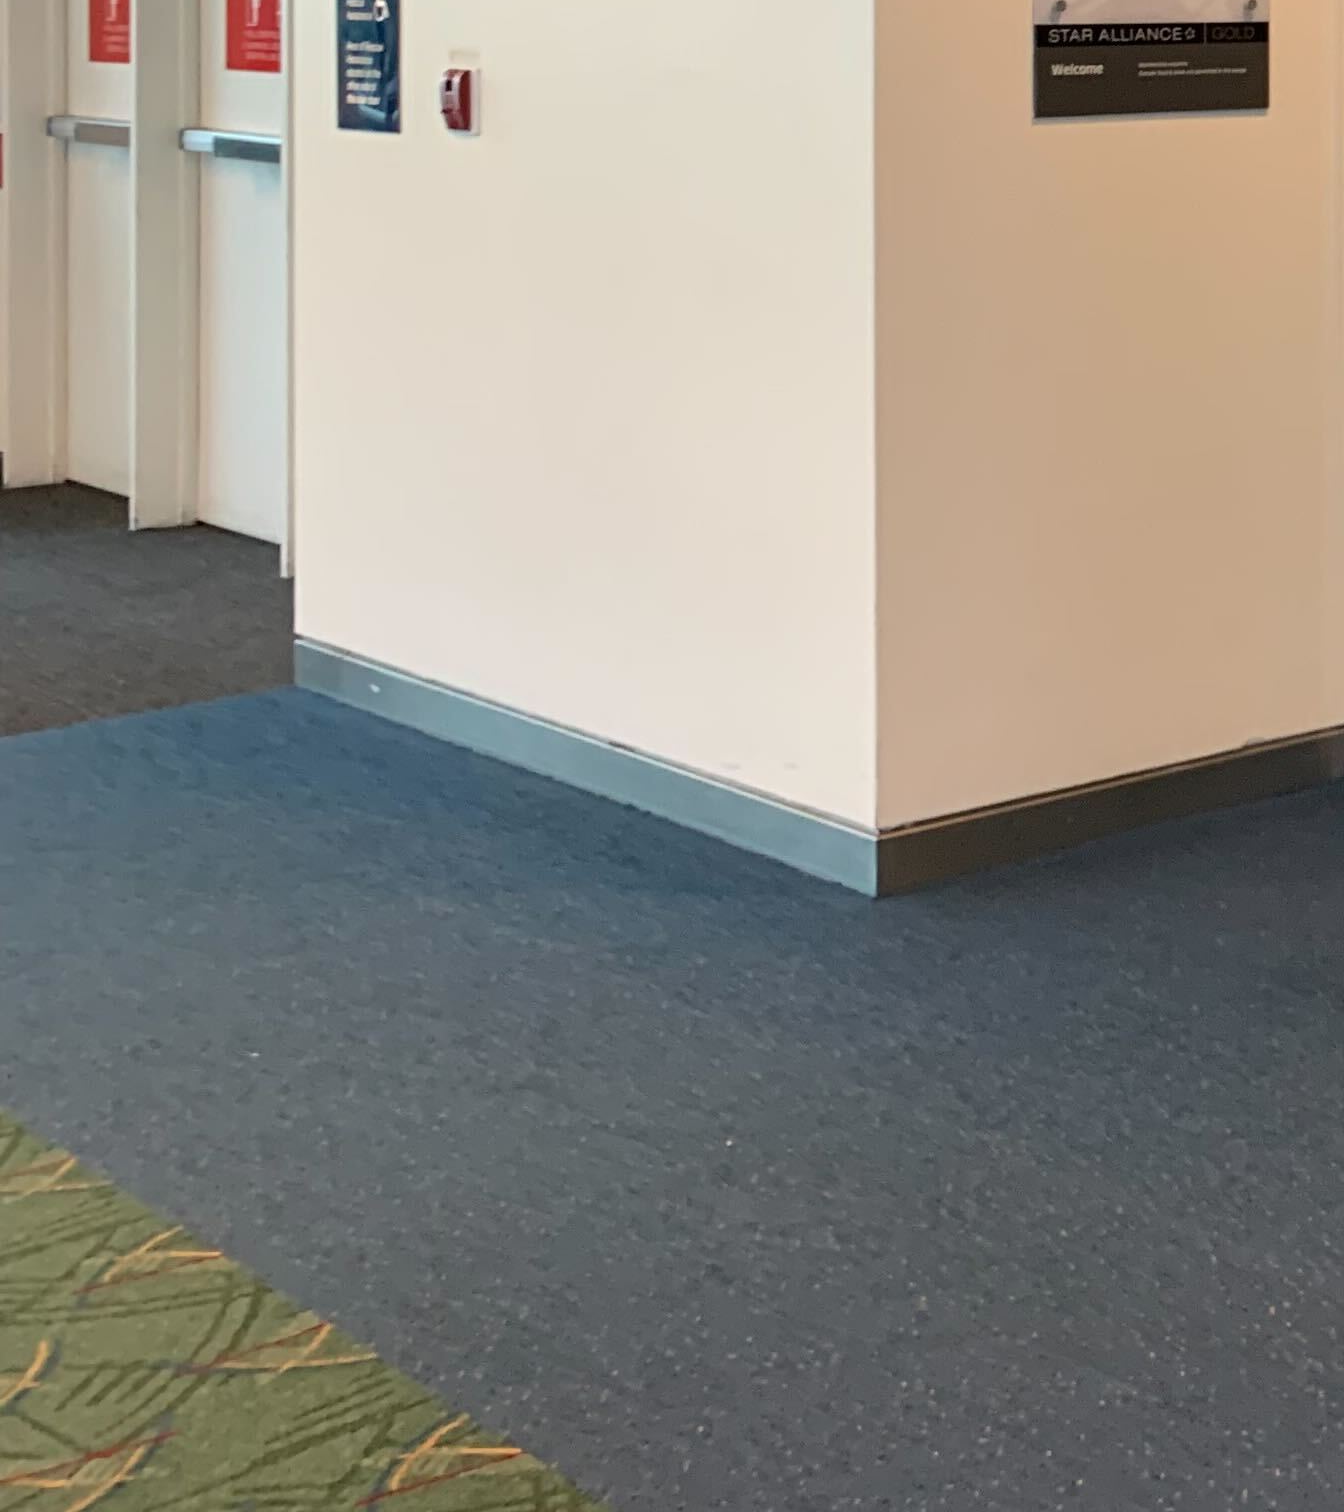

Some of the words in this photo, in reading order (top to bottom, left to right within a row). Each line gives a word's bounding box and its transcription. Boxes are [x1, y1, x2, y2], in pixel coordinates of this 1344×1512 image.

[1048, 28, 1093, 43] STAR
[1099, 26, 1183, 42] ALLIANCE
[1211, 25, 1256, 40] GOLD
[1051, 62, 1104, 76] Welcome
